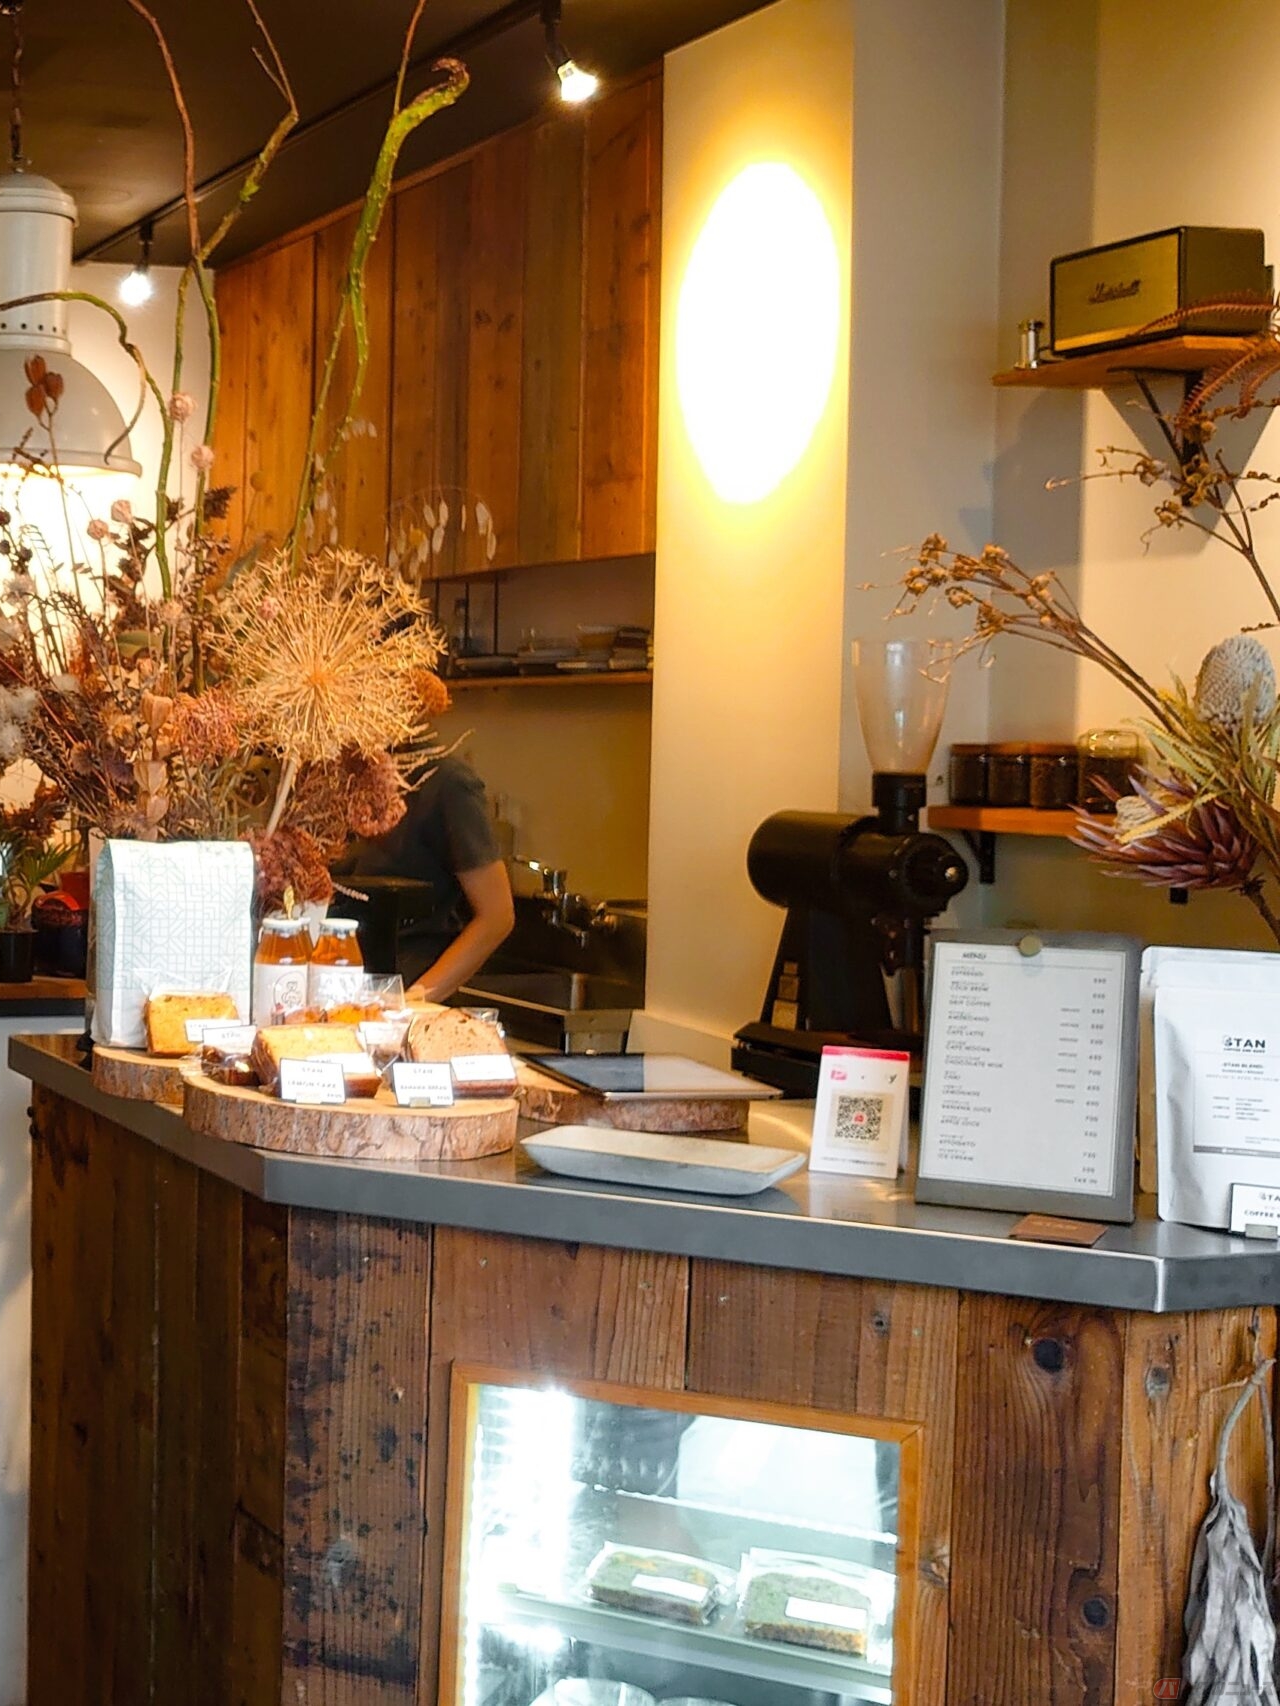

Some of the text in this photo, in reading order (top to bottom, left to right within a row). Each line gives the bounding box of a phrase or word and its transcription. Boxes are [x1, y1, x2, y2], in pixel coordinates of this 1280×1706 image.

[962, 951, 987, 960] MENU
[1223, 1035, 1266, 1049] STAN
[1243, 1209, 1274, 1219] COFFEE
